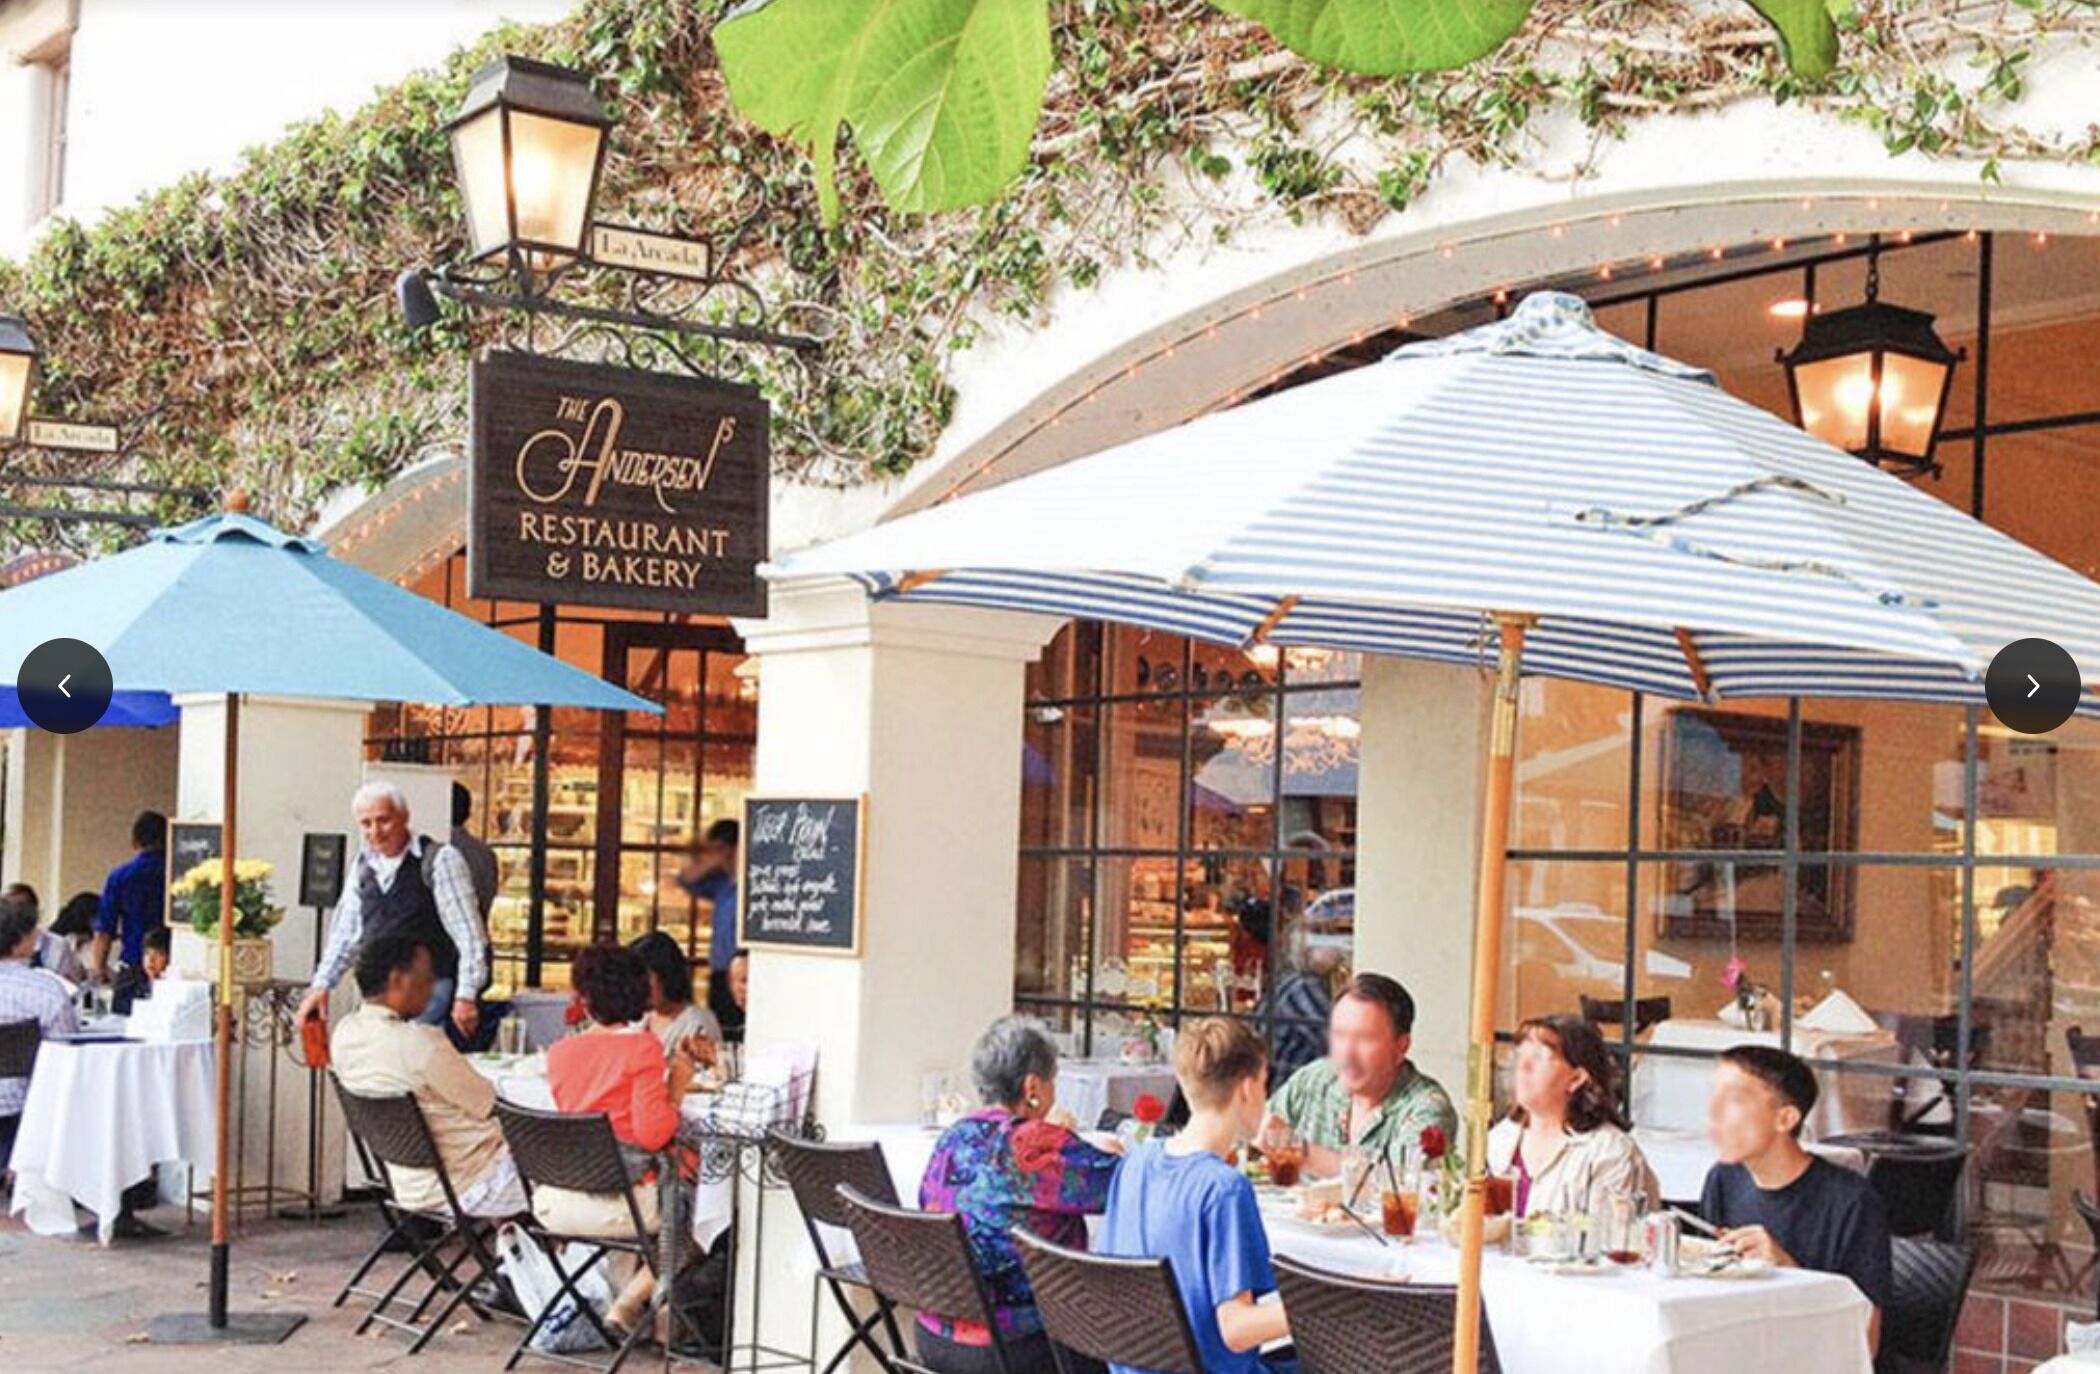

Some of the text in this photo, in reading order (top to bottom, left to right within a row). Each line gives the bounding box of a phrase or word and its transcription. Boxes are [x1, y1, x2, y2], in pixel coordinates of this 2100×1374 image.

[601, 233, 699, 267] La Arcada
[556, 397, 590, 422] THE
[519, 511, 730, 558] RESTAURANT
[546, 551, 701, 589] & BAKERY
